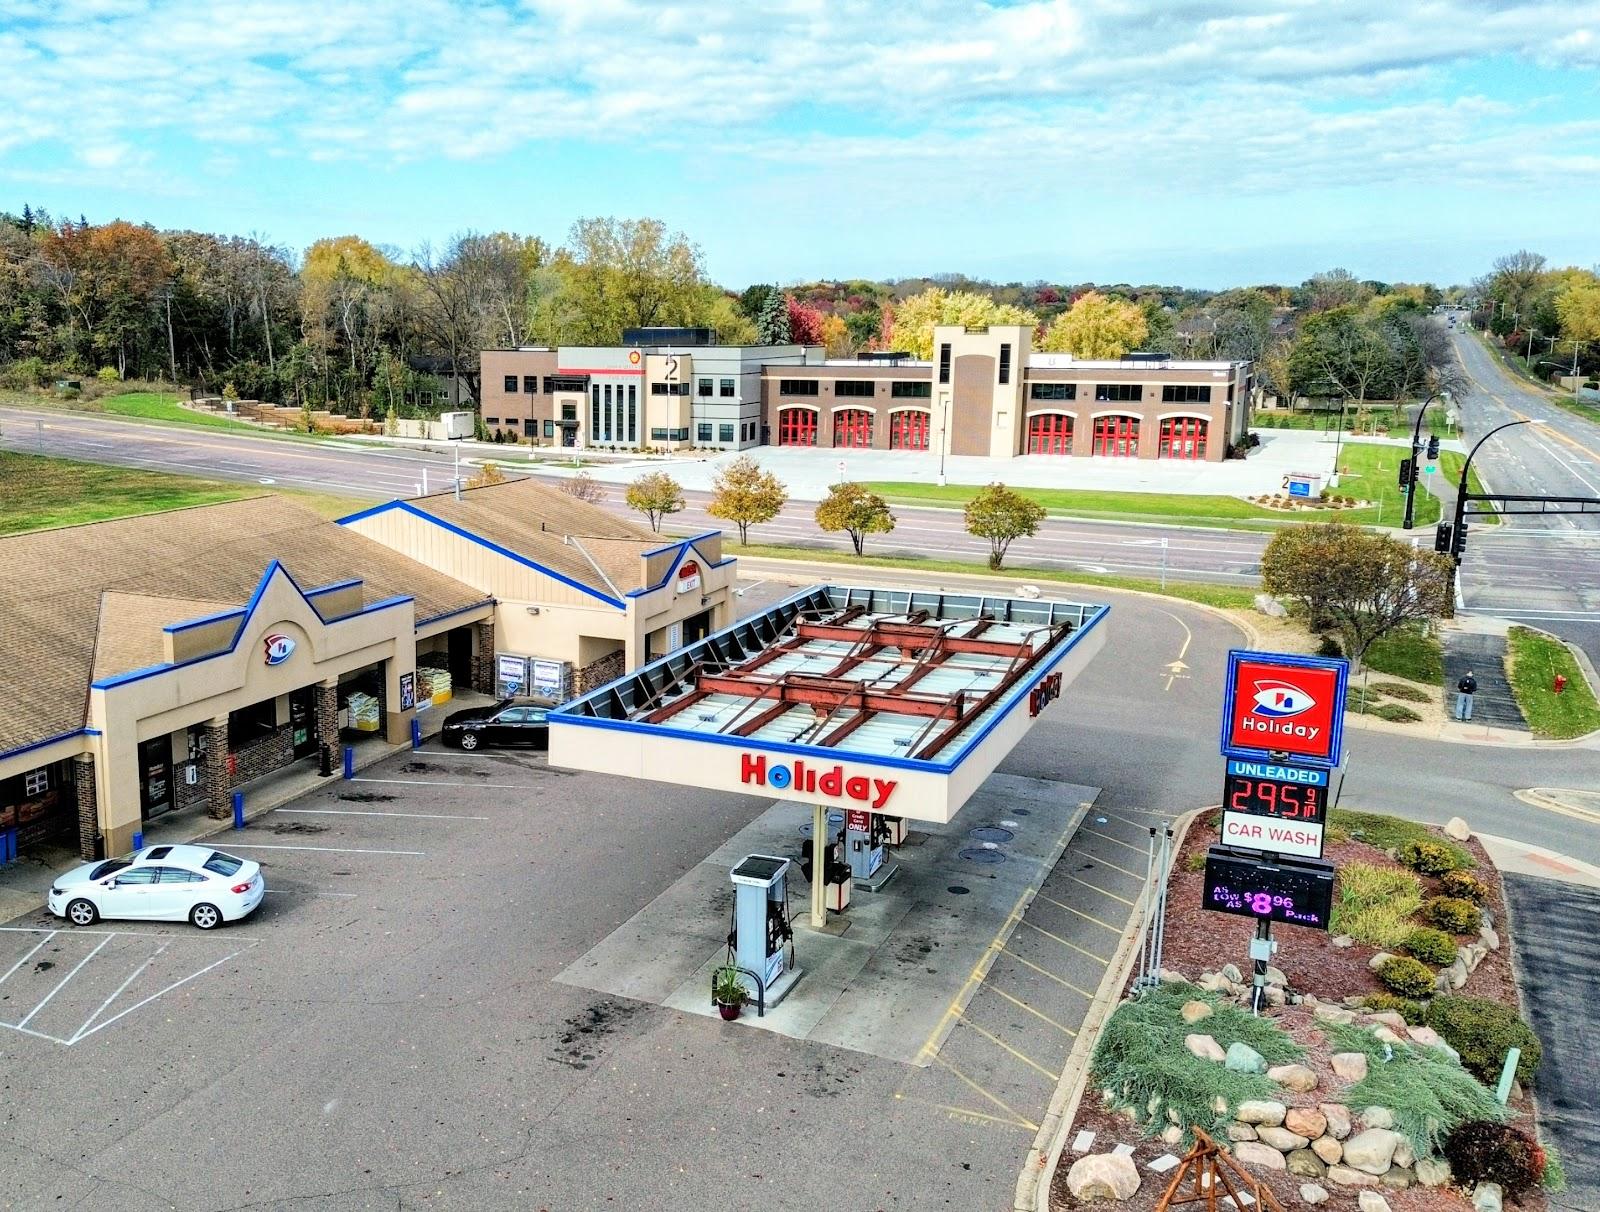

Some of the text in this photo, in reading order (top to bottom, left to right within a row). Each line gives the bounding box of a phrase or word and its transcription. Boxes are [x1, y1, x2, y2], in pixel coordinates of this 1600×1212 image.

[665, 355, 678, 380] 2
[1282, 476, 1290, 489] 2
[1242, 716, 1320, 740] Holiday
[741, 752, 899, 809] Holiday
[1235, 762, 1320, 783] UNLEADED
[848, 823, 868, 832] ONLY
[1228, 822, 1318, 846] CAR WASH
[1226, 900, 1242, 908] AS
